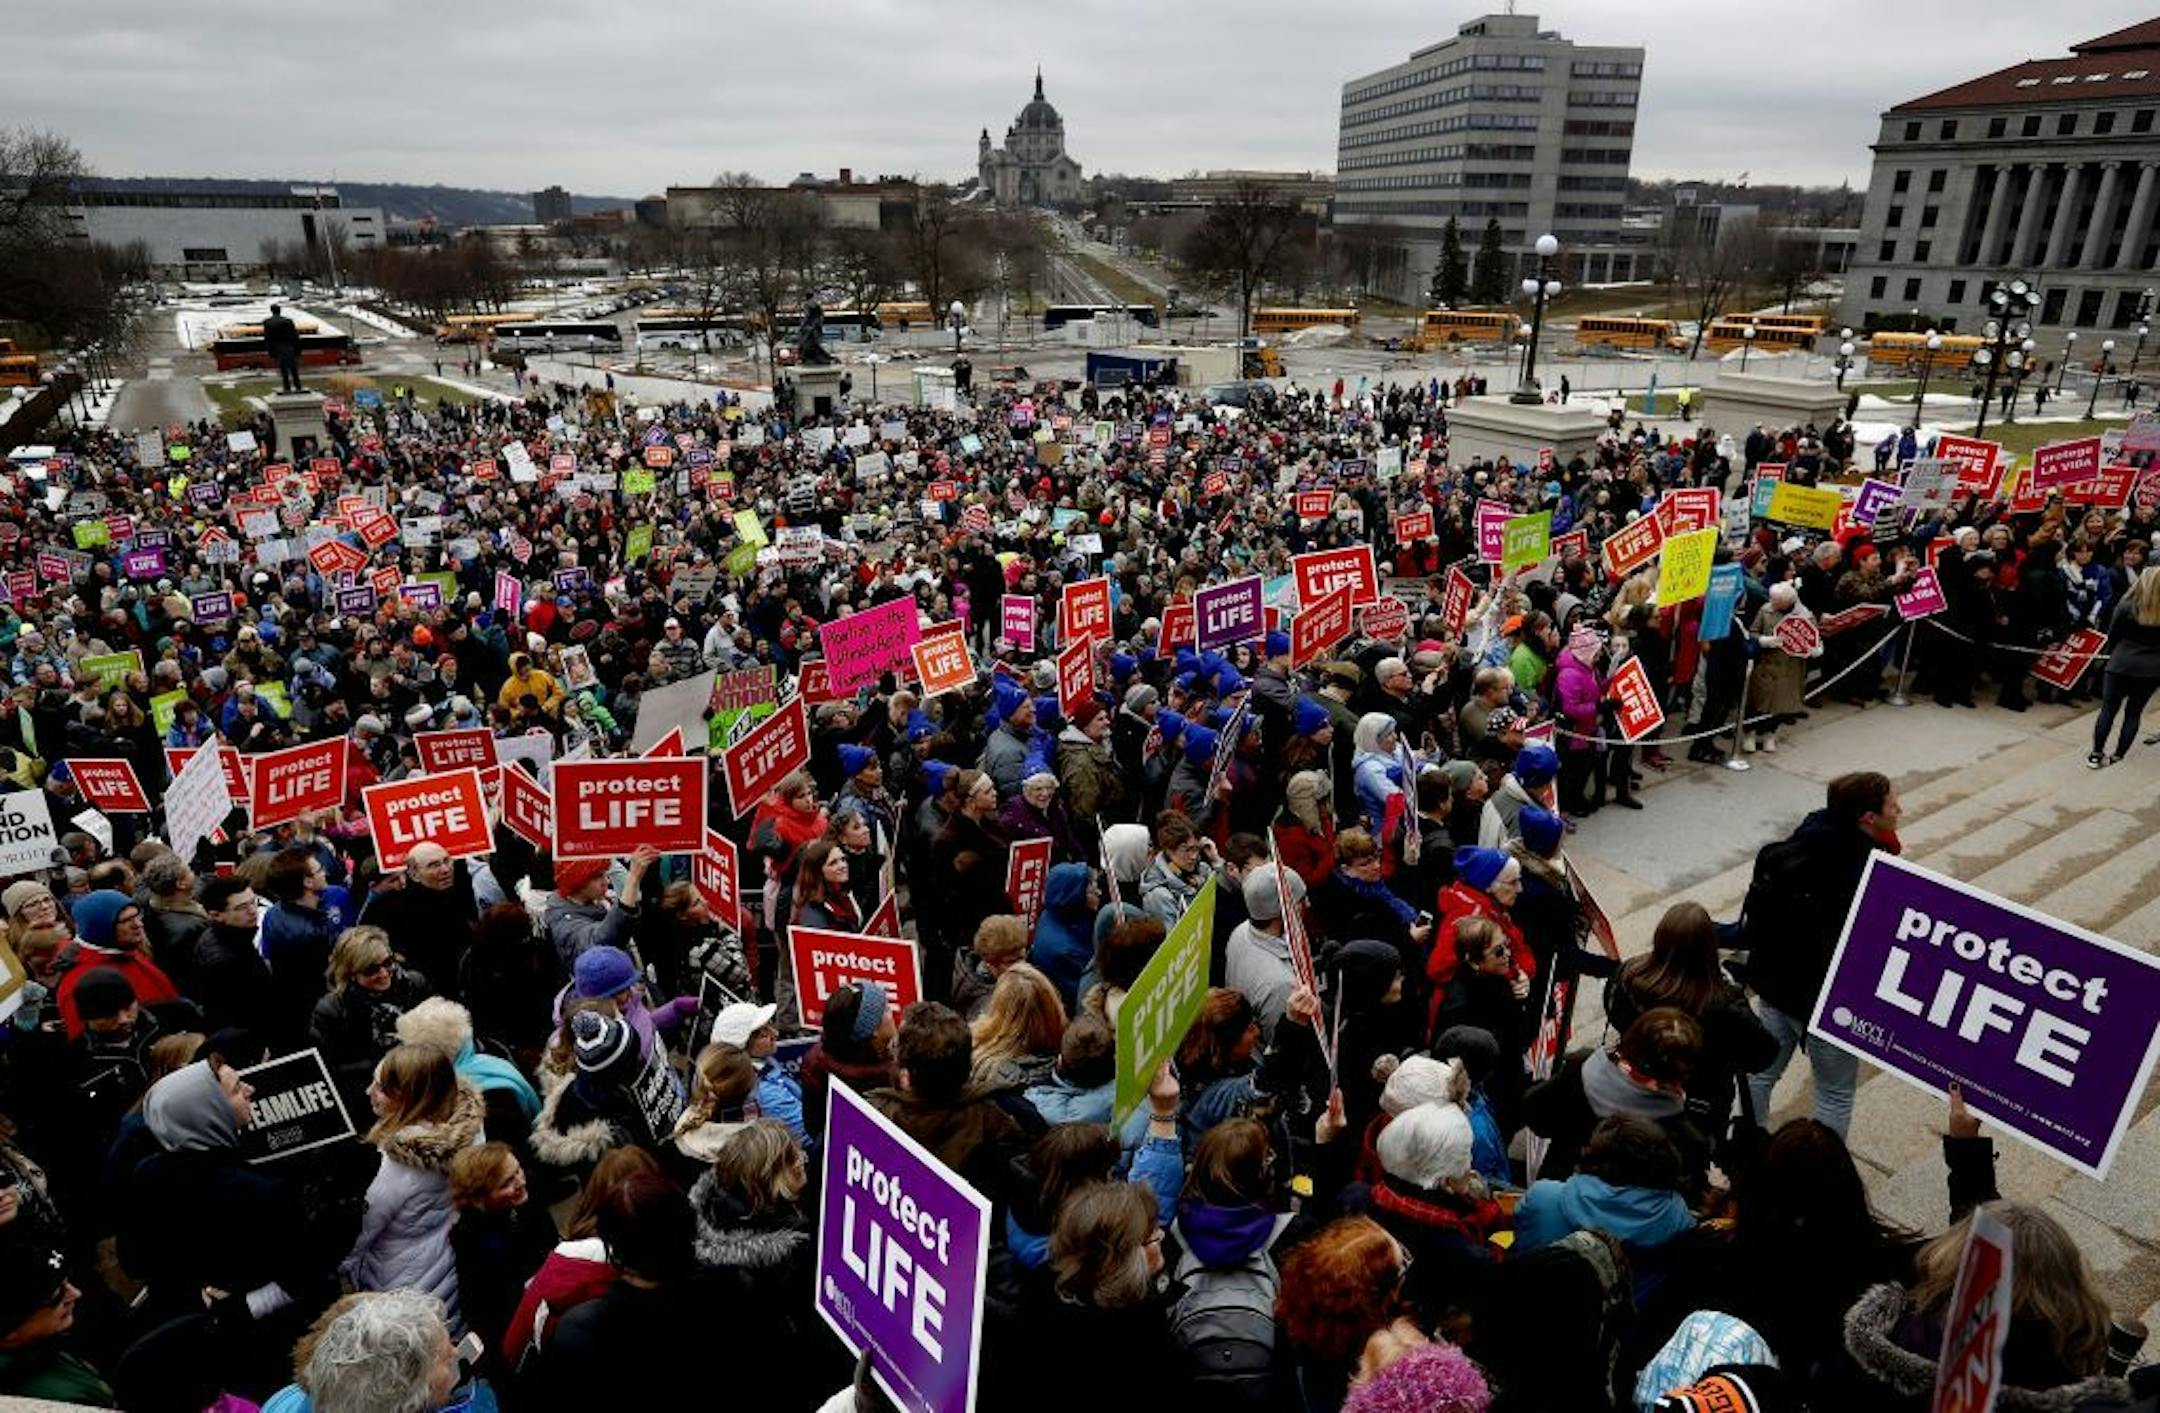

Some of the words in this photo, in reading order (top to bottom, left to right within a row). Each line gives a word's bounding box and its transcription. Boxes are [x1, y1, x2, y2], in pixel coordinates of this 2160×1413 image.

[1961, 457, 1987, 473] FE
[2041, 446, 2093, 464] protege
[2041, 464, 2058, 475] LA
[2061, 458, 2092, 471] VIDA
[2074, 480, 2121, 497] LIFE
[1616, 530, 1654, 562] LIFE
[1307, 557, 1360, 576] protect
[1308, 571, 1364, 596] LIFE
[1206, 588, 1252, 612] protect
[1073, 604, 1104, 629] LIFE
[1207, 602, 1254, 634] LIFE
[1301, 608, 1343, 651] LIFE
[926, 653, 963, 678] LIFE
[1064, 663, 1090, 700] LIFE
[1616, 678, 1647, 725] LIFE
[1628, 671, 1656, 717] protect
[430, 736, 482, 751] protect
[433, 749, 487, 765] LIFE
[739, 715, 793, 768] protect
[268, 751, 334, 778] protect
[741, 731, 796, 789] LIFE
[86, 779, 134, 796] LIFE
[268, 770, 333, 805] LIFE
[385, 785, 464, 814] protect
[579, 774, 682, 796] protect
[516, 787, 550, 816] prot
[579, 797, 682, 830] LIFE
[391, 804, 471, 847] LIFE
[699, 858, 731, 903] LIFE
[811, 949, 896, 976] protect
[1132, 917, 1204, 1035] protect
[1895, 907, 2109, 1015] protect
[1133, 949, 1200, 1078] LIFE
[1874, 946, 2092, 1088] LIFE
[847, 1143, 952, 1266] protect
[840, 1194, 946, 1364] LIFE
